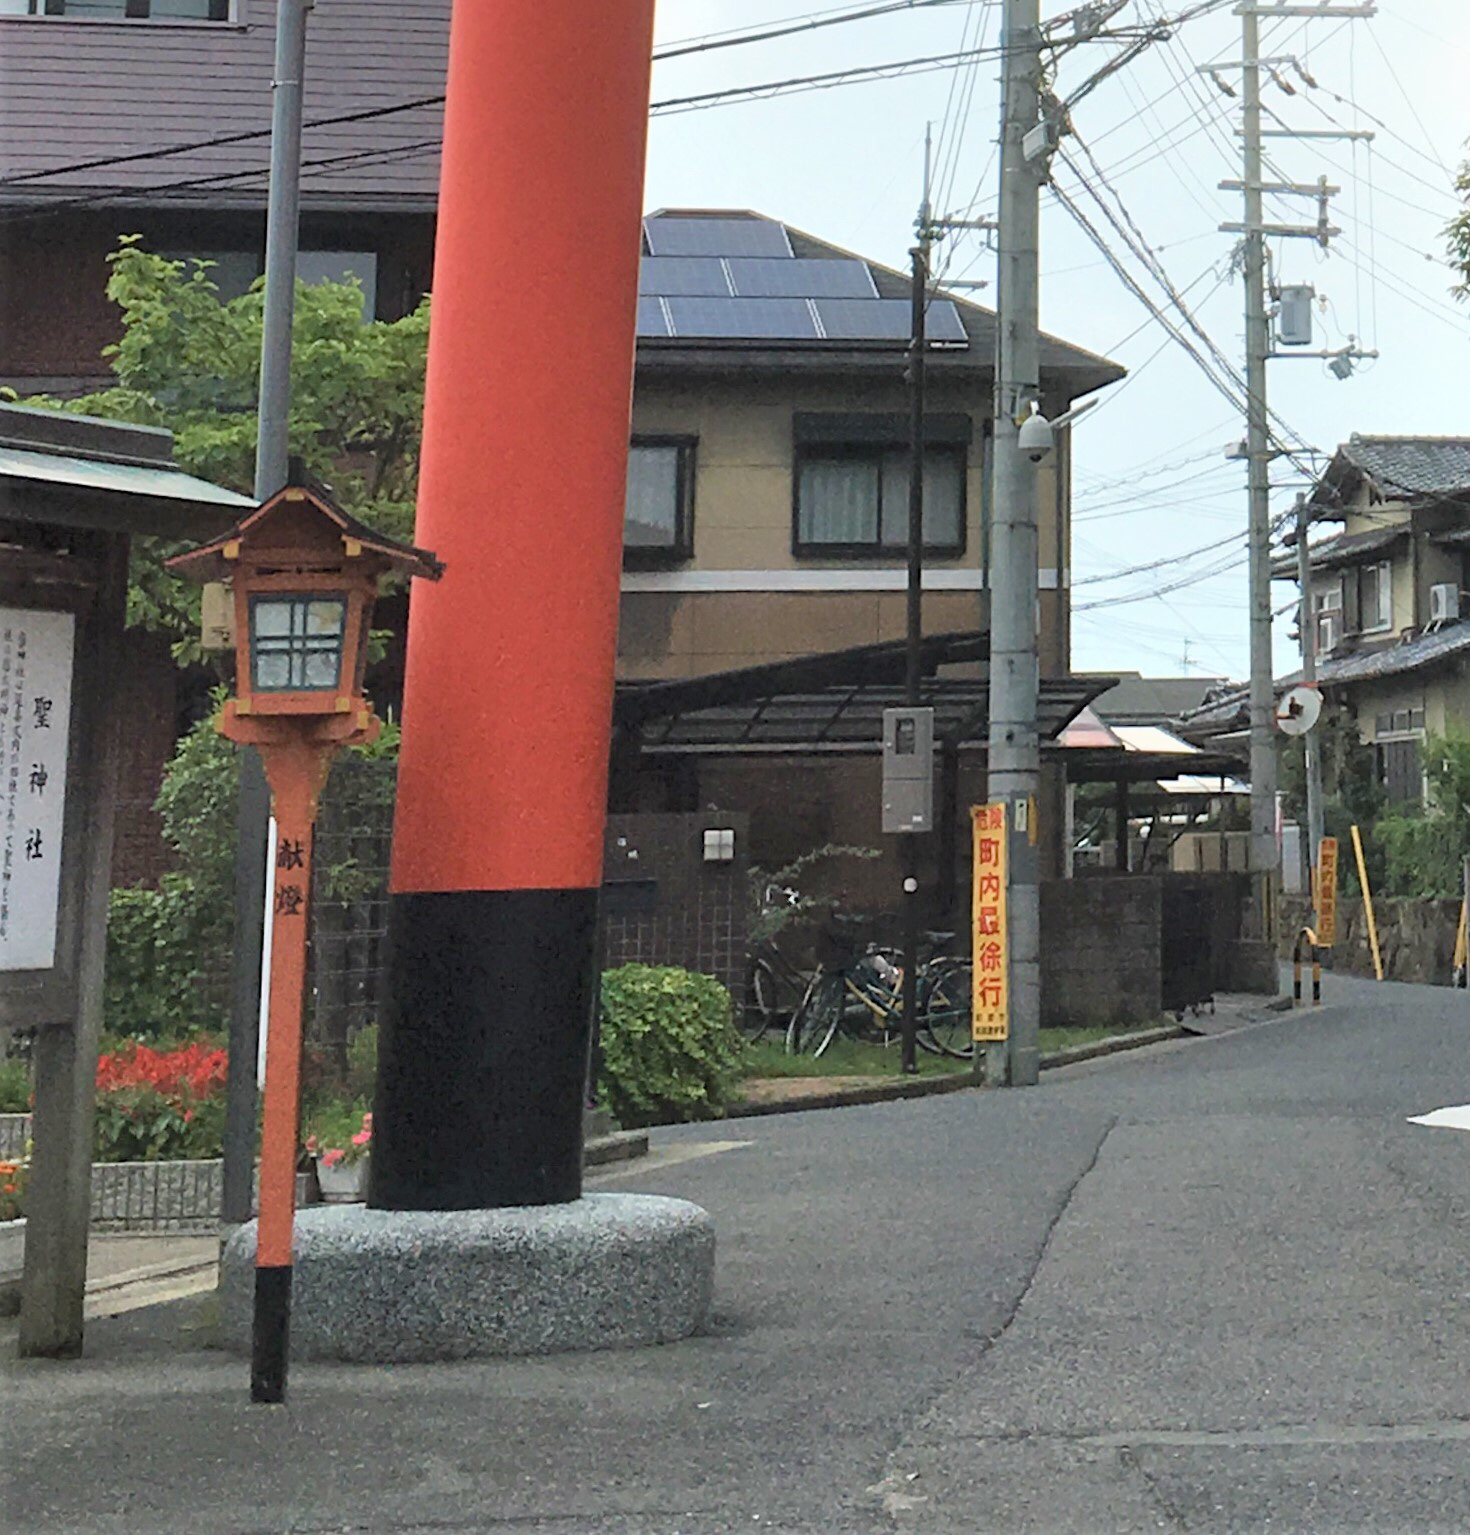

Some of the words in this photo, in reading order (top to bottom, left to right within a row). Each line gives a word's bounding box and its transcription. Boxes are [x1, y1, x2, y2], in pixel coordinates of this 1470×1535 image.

[25, 696, 53, 861] 聖神社
[978, 837, 1002, 1007] 町内最徐行
